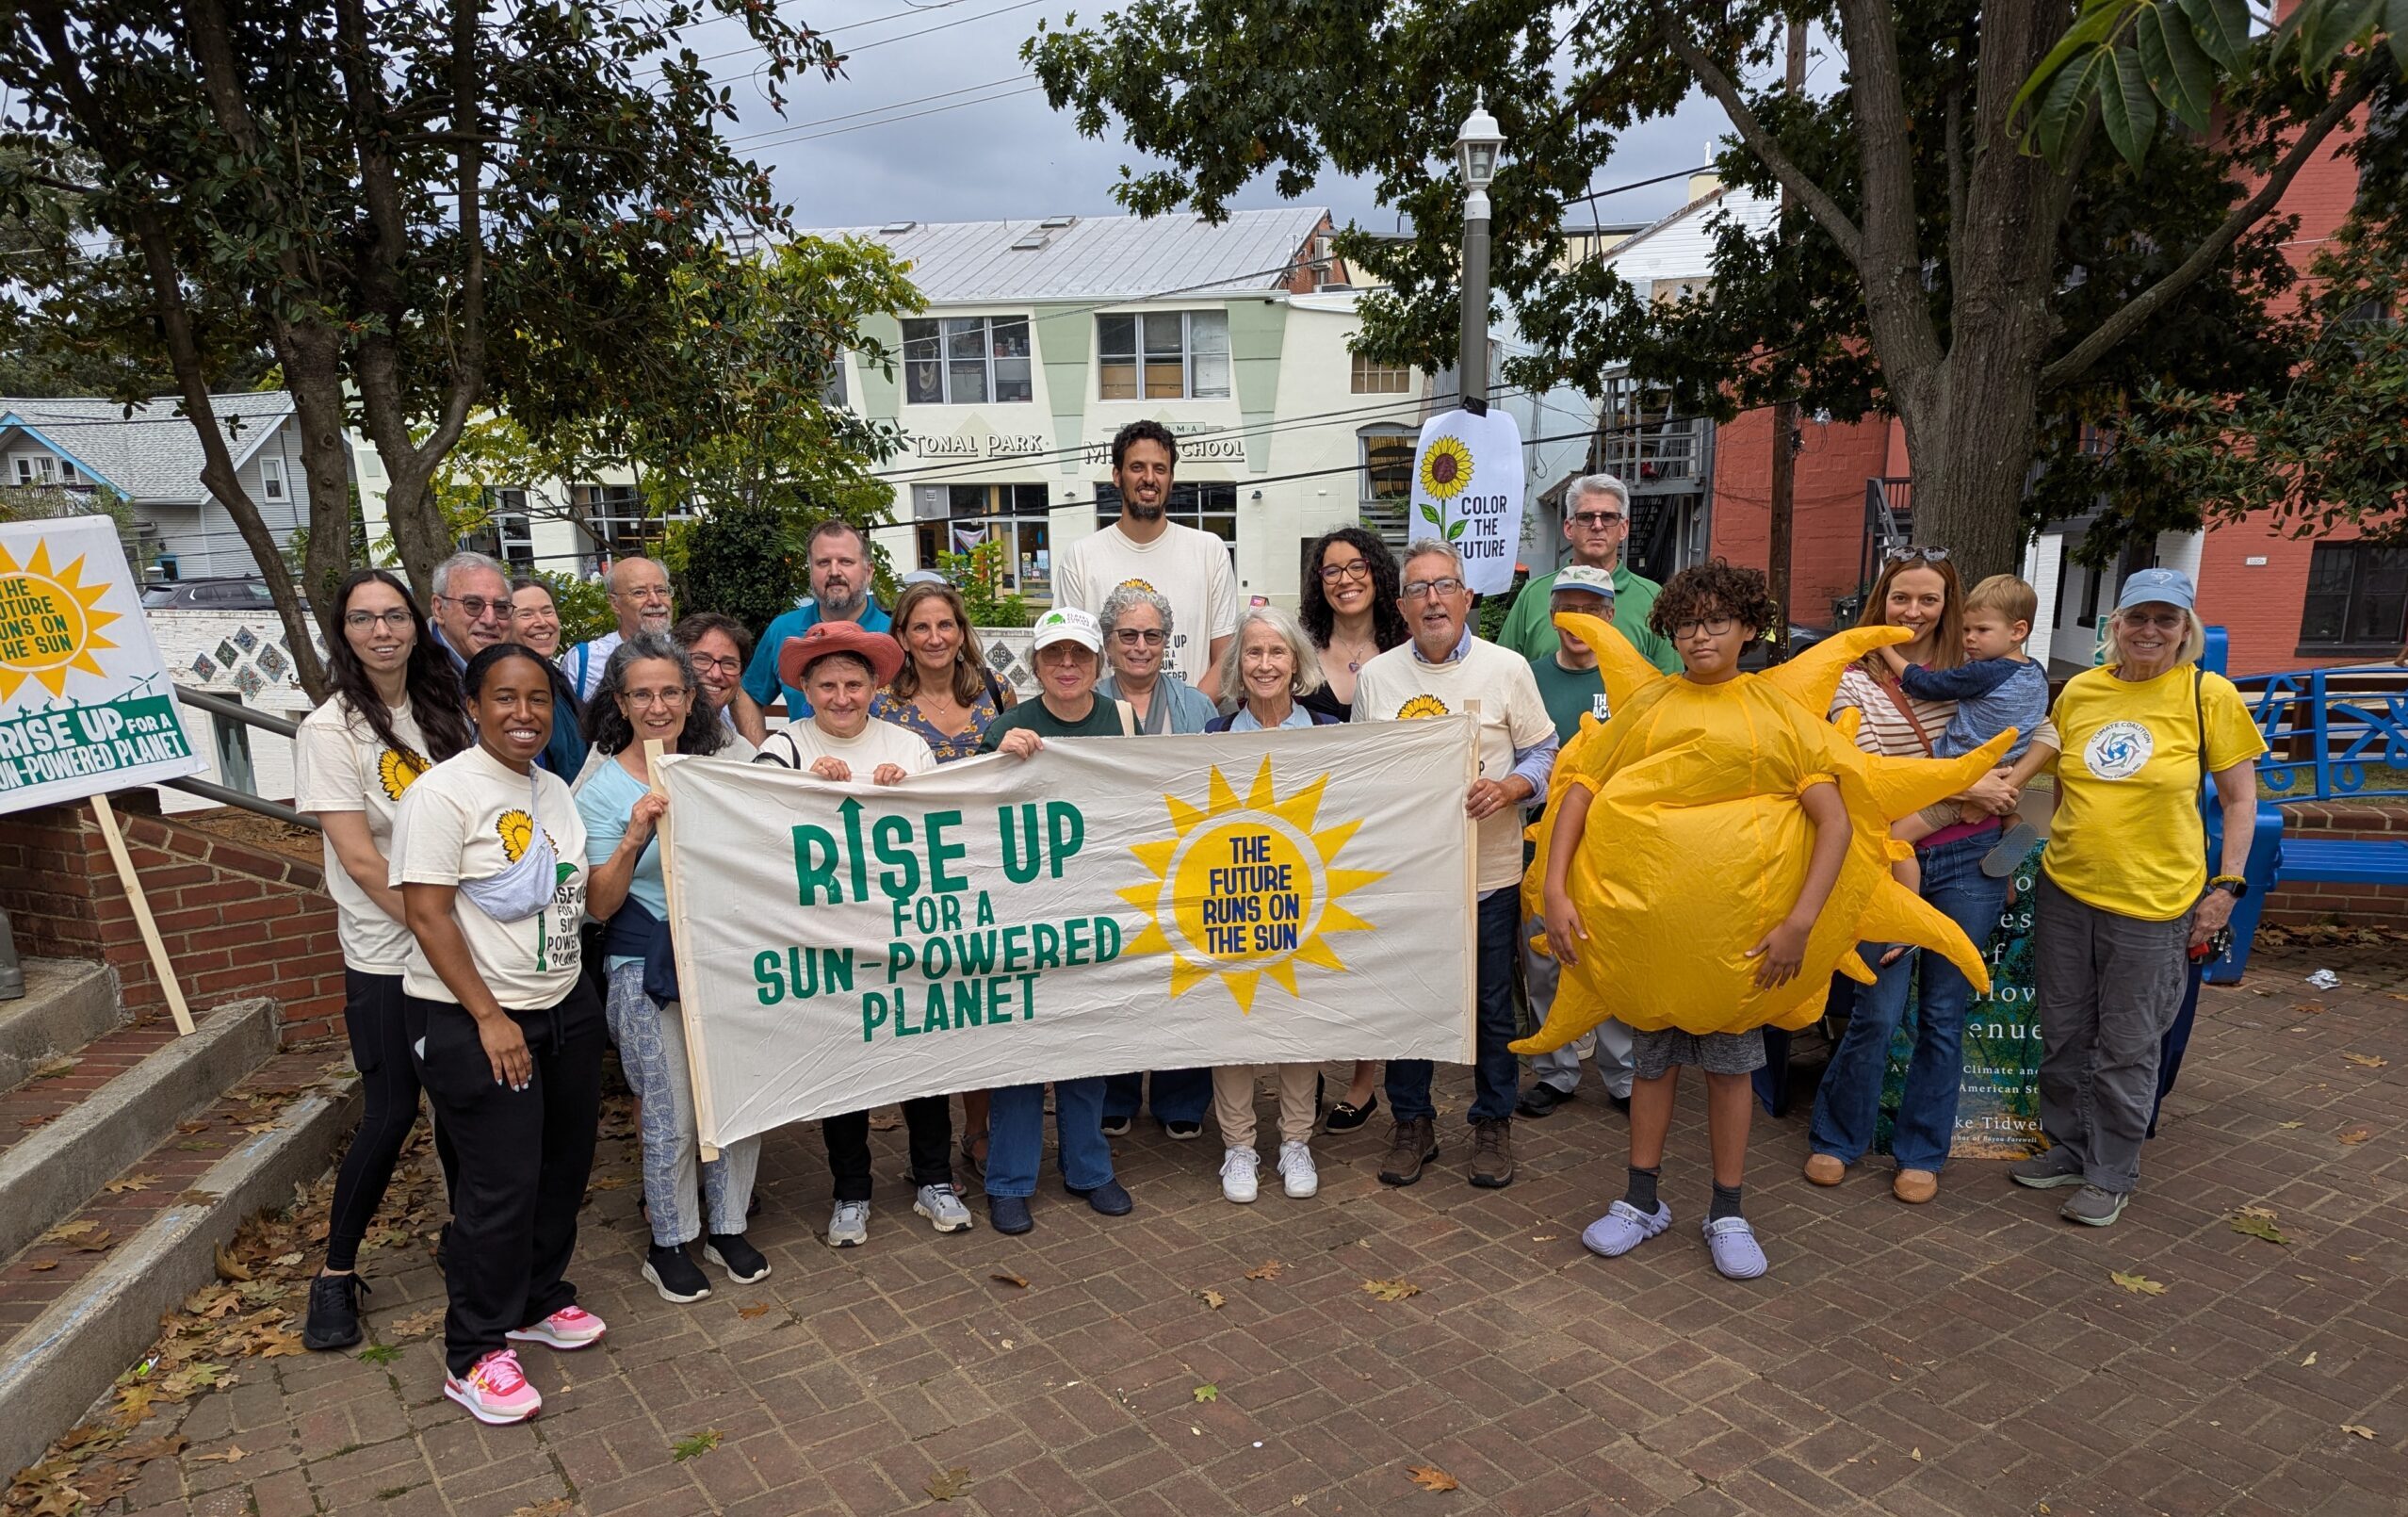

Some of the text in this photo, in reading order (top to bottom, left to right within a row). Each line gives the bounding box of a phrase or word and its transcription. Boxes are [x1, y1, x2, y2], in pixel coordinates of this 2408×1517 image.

[910, 434, 1245, 461] TONAL PARK CHOOL
[1461, 496, 1507, 515] COLOR
[1474, 518, 1498, 536] THE
[1455, 539, 1505, 560] FUTURE
[0, 579, 30, 599] HE
[0, 595, 55, 620] UTURE
[0, 614, 68, 640] UNS ON
[0, 634, 73, 661] HE SUN
[1174, 634, 1187, 648] UP
[0, 708, 172, 758] RISE UP FOR A
[2091, 722, 2152, 743] CLIMATE COALITION
[0, 730, 186, 791] UN-POWERED PLANET
[1479, 760, 1485, 775] P
[791, 795, 1084, 906] RISE UP
[1229, 835, 1271, 864] THE
[1210, 864, 1292, 896] FUTURE
[892, 889, 996, 938] FOR A
[1203, 893, 1300, 925] RUNS ON
[1205, 922, 1297, 954] THE SUN
[754, 916, 1121, 1005] SUN-POWERED
[863, 971, 1040, 1042] PLANET
[1969, 1023, 2042, 1039] enue
[1962, 1065, 2013, 1075] Climate
[2019, 1067, 2038, 1075] an
[1959, 1084, 2019, 1094] American
[1955, 1115, 2042, 1131] ke Tidwel
